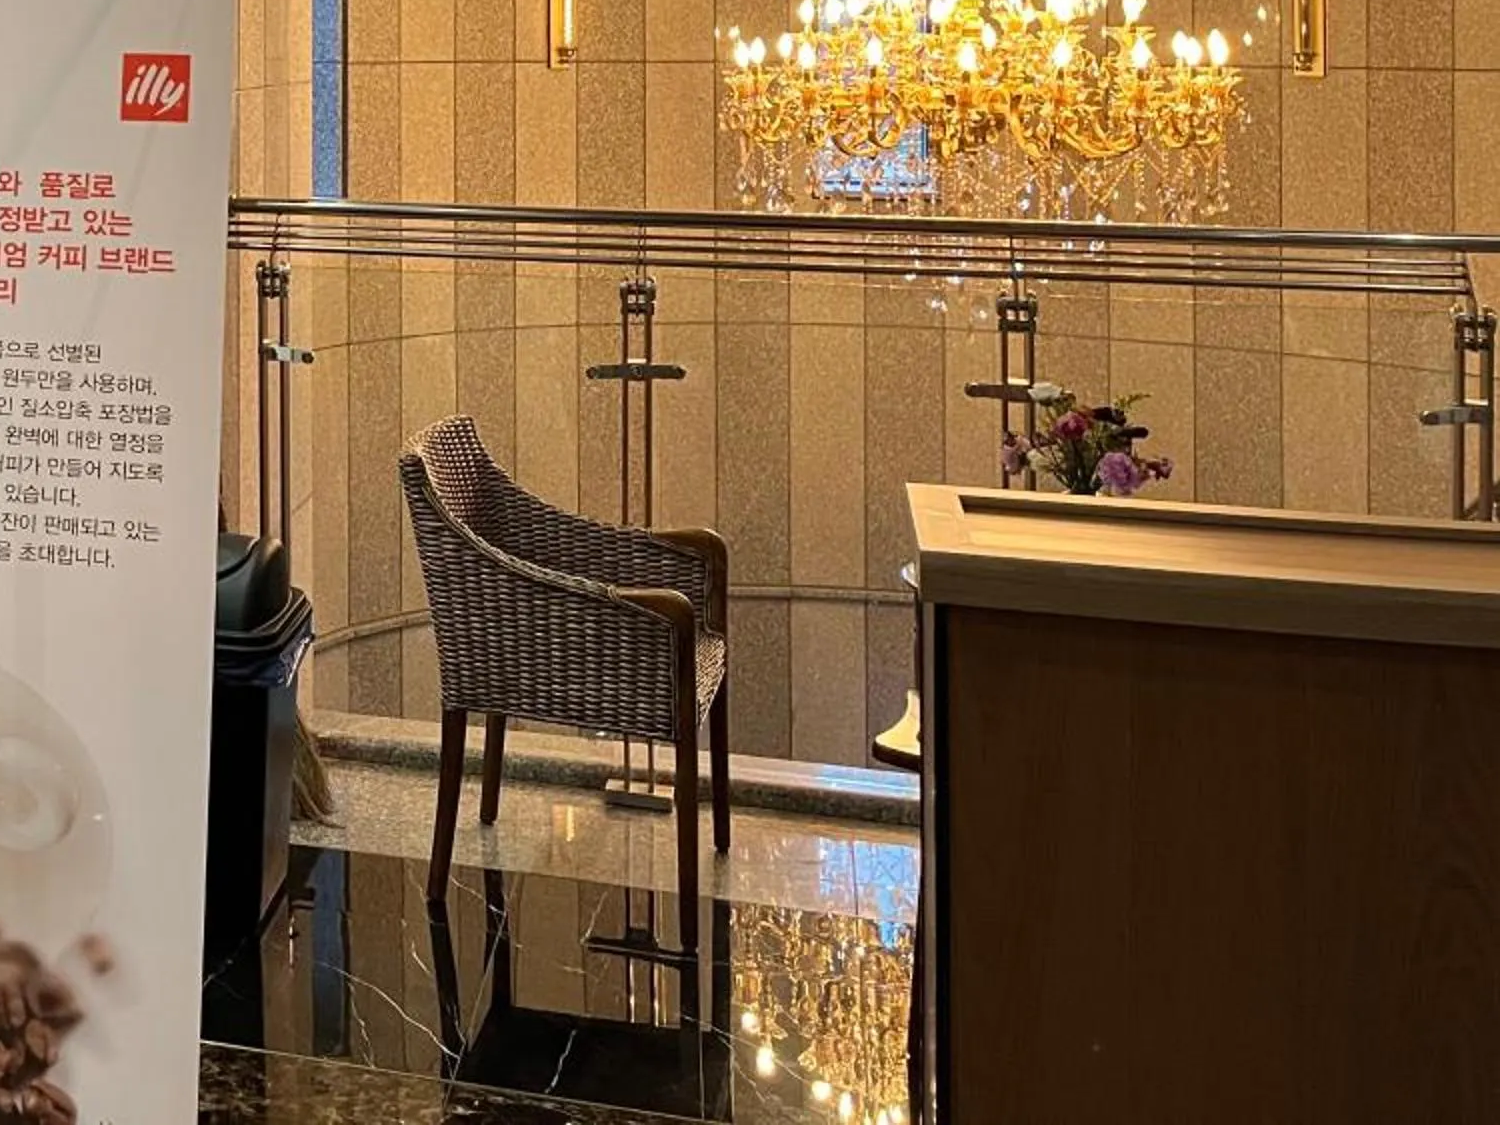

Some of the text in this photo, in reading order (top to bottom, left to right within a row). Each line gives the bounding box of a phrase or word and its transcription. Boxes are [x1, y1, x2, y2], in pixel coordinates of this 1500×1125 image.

[125, 64, 185, 116] illy
[40, 172, 115, 199] 품질로
[83, 209, 133, 236] 있는
[38, 243, 87, 270] 커피
[97, 246, 175, 275] 브랜드
[47, 343, 101, 364] 선별된
[2, 369, 72, 392] 원두만을
[20, 397, 92, 421] 질소압축
[98, 401, 172, 425] 포장법을
[5, 426, 59, 447] 완벽에
[67, 429, 101, 450] 대한
[110, 432, 164, 454] 열정을
[47, 457, 101, 479] 만들어
[109, 461, 164, 483] 지도록
[4, 484, 81, 507] 있습니다.
[0, 512, 37, 534] 잔이
[44, 515, 116, 538] 판매되고
[124, 521, 161, 542] 있는
[19, 541, 115, 568] 초대합니다.
